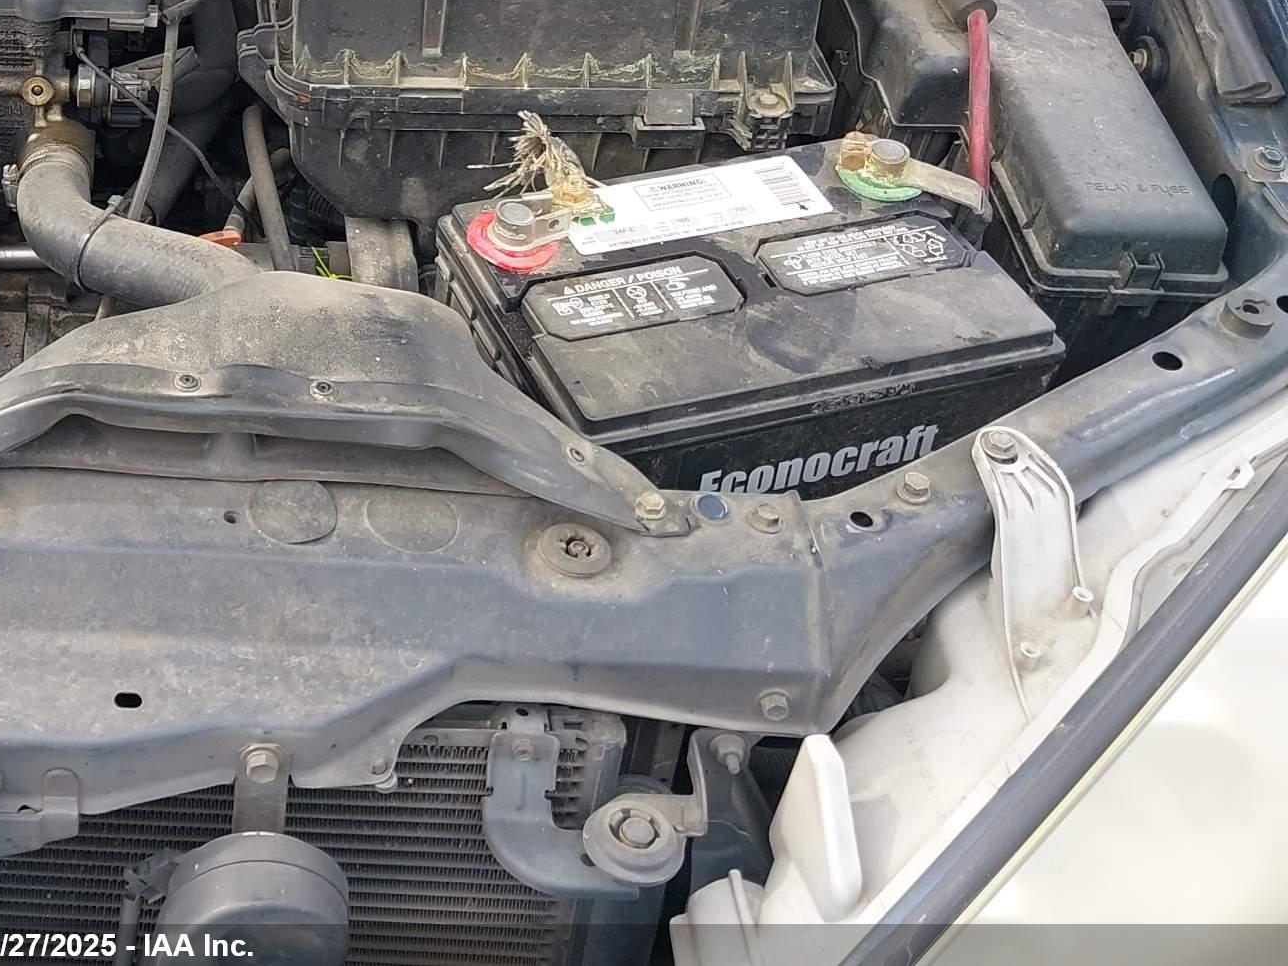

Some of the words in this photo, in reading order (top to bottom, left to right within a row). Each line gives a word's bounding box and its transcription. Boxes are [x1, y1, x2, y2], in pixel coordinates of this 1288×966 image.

[574, 277, 627, 293] DANGER
[635, 266, 683, 282] POISON
[699, 424, 940, 494] Econocraft
